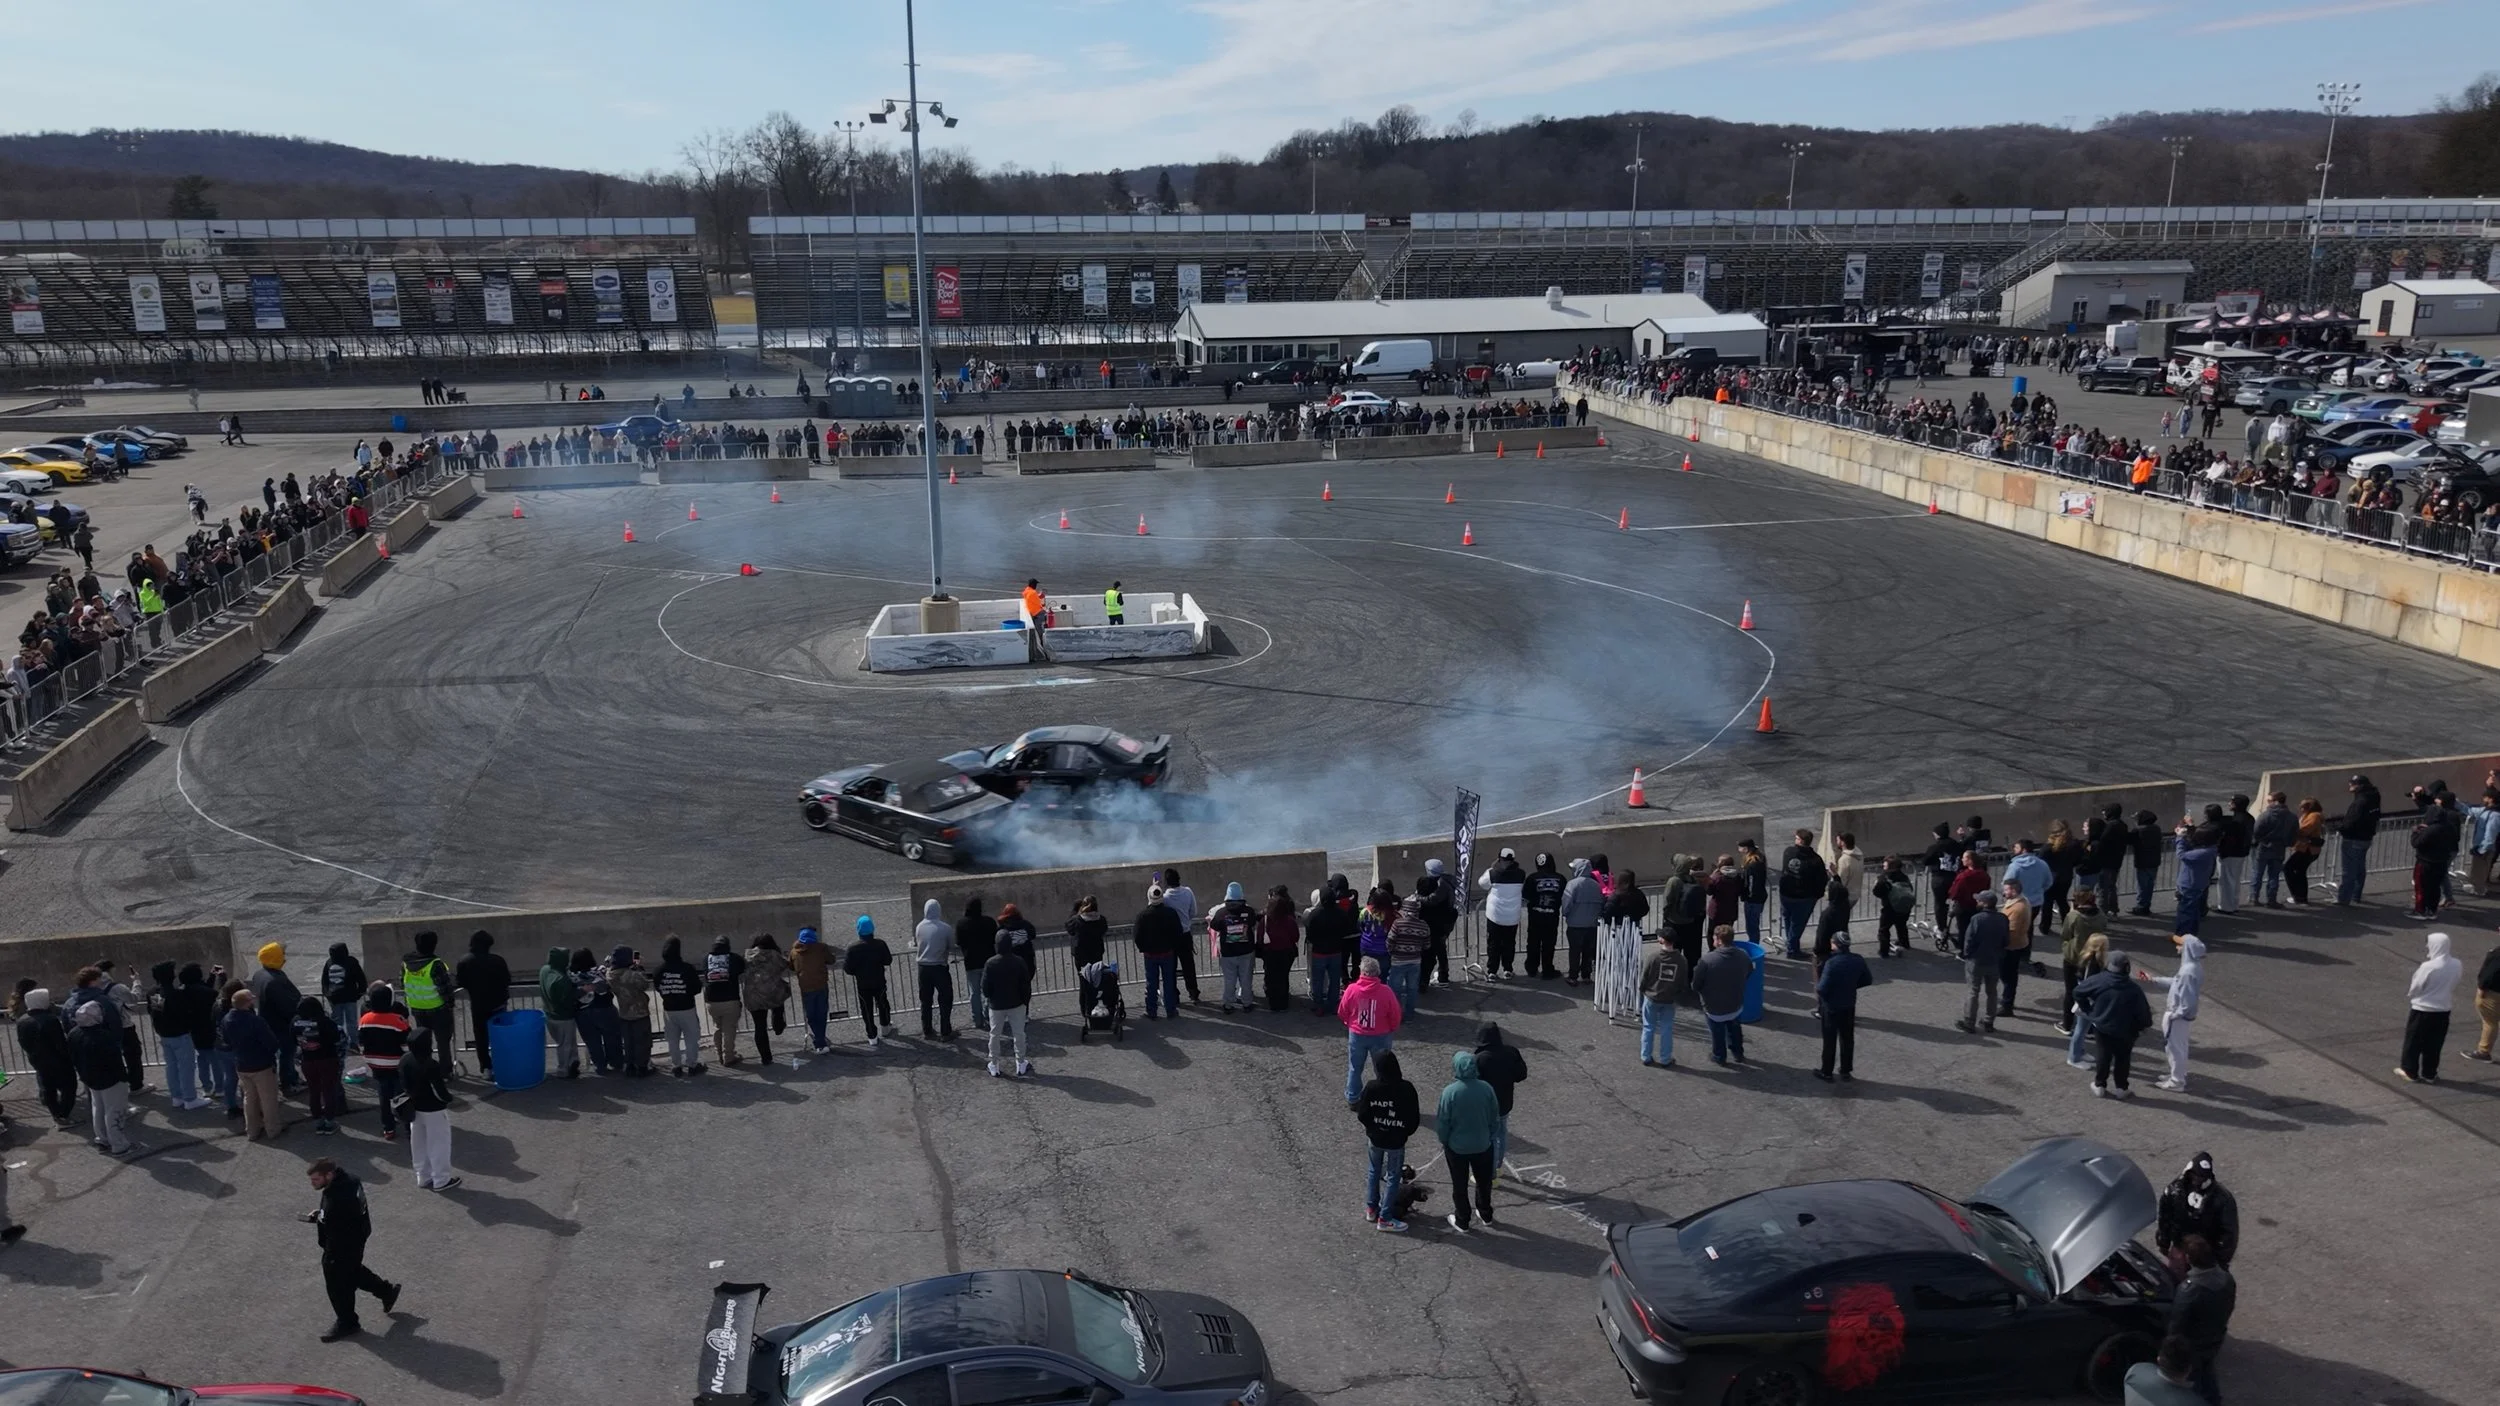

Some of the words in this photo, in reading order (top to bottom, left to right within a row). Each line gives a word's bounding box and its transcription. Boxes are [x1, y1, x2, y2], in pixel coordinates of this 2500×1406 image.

[938, 278, 955, 290] Red
[937, 287, 958, 300] Roof
[1369, 1100, 1394, 1108] MADE
[711, 1349, 729, 1394] NIGHT
[720, 1298, 737, 1339] BURNERS
[728, 1328, 738, 1361] CREW
